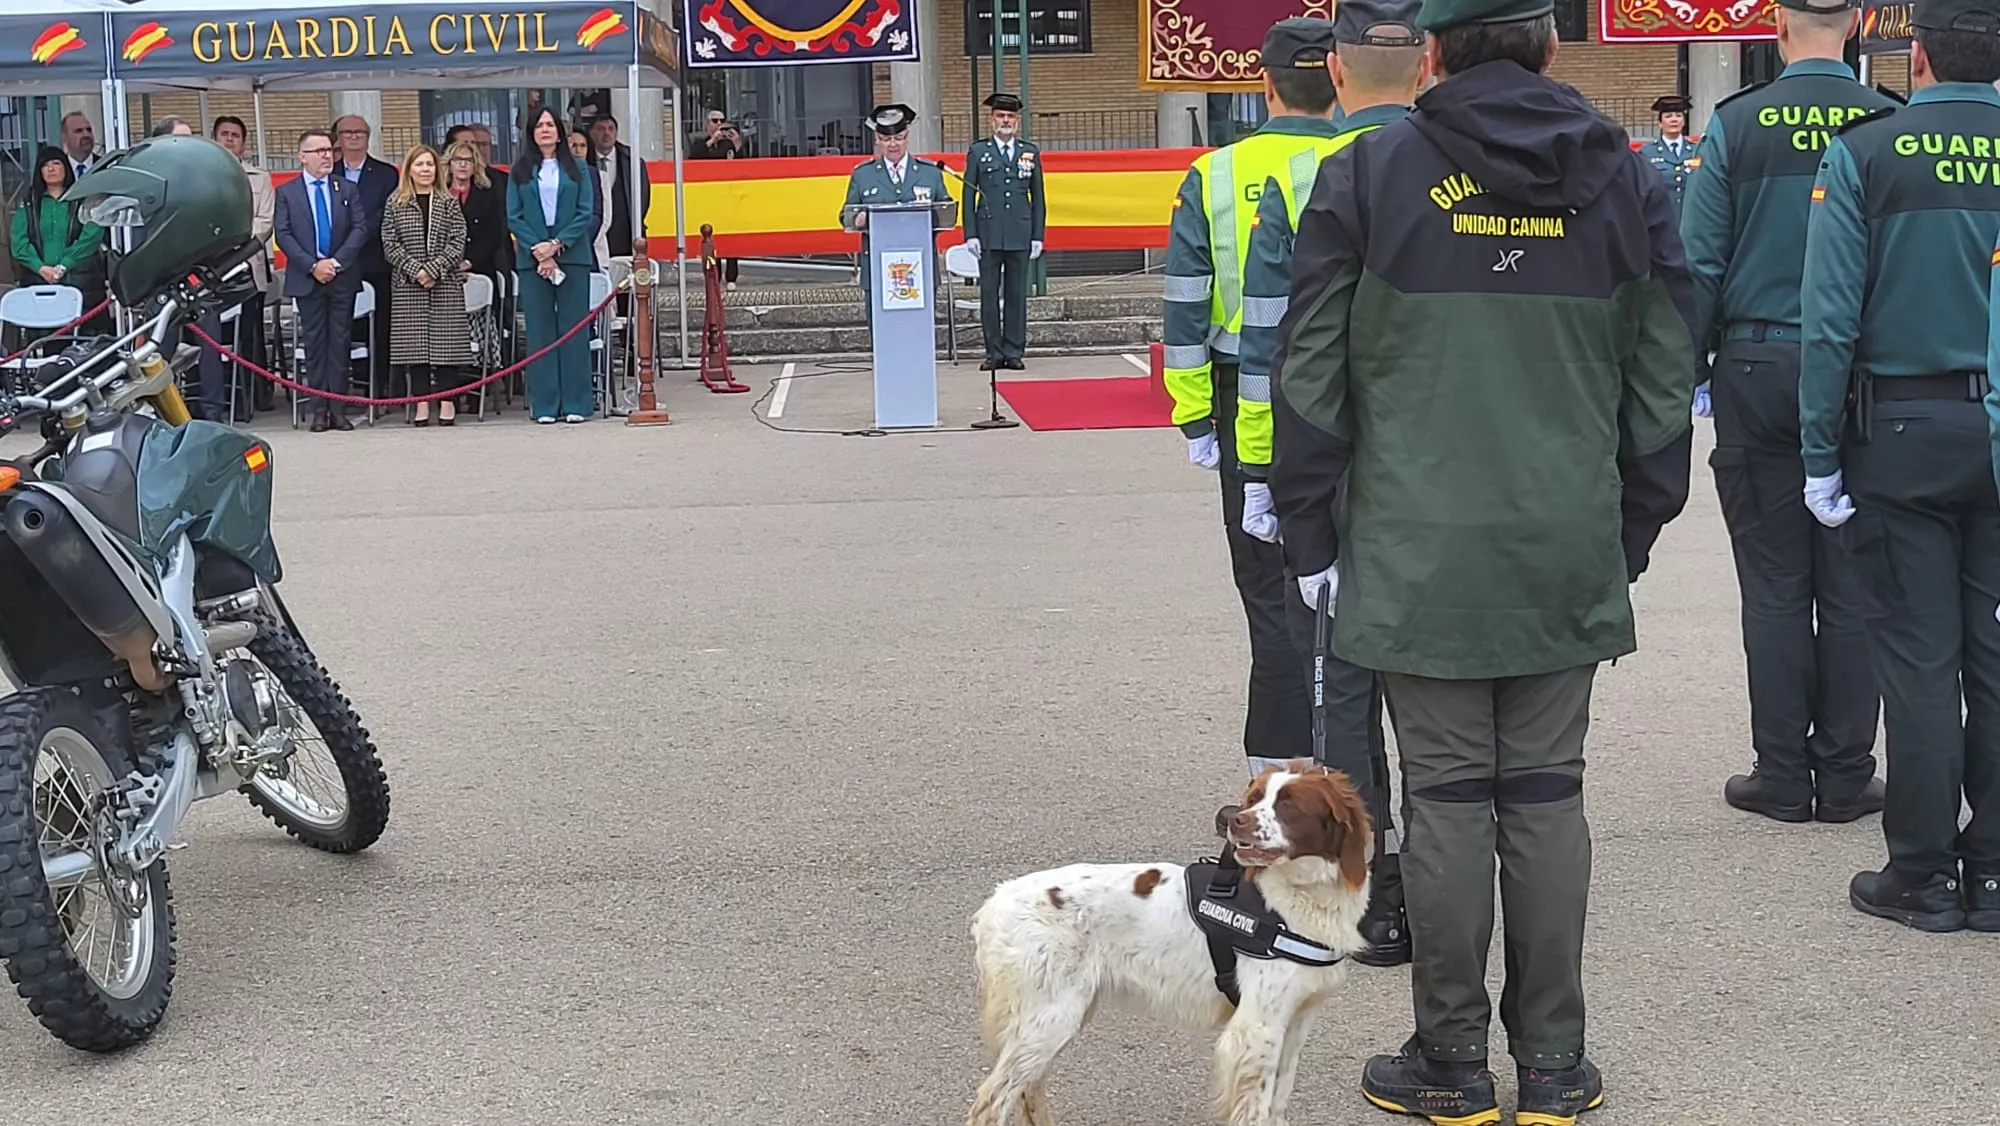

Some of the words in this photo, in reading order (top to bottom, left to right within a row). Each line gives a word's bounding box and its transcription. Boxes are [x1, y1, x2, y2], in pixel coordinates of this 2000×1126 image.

[191, 14, 414, 63] GUARDIA
[429, 11, 560, 55] CIVIL
[1452, 213, 1507, 236] UNIDAD
[1510, 216, 1565, 238] CANINA
[1198, 899, 1234, 926] GUARDIA
[1232, 913, 1256, 934] CIVIL
